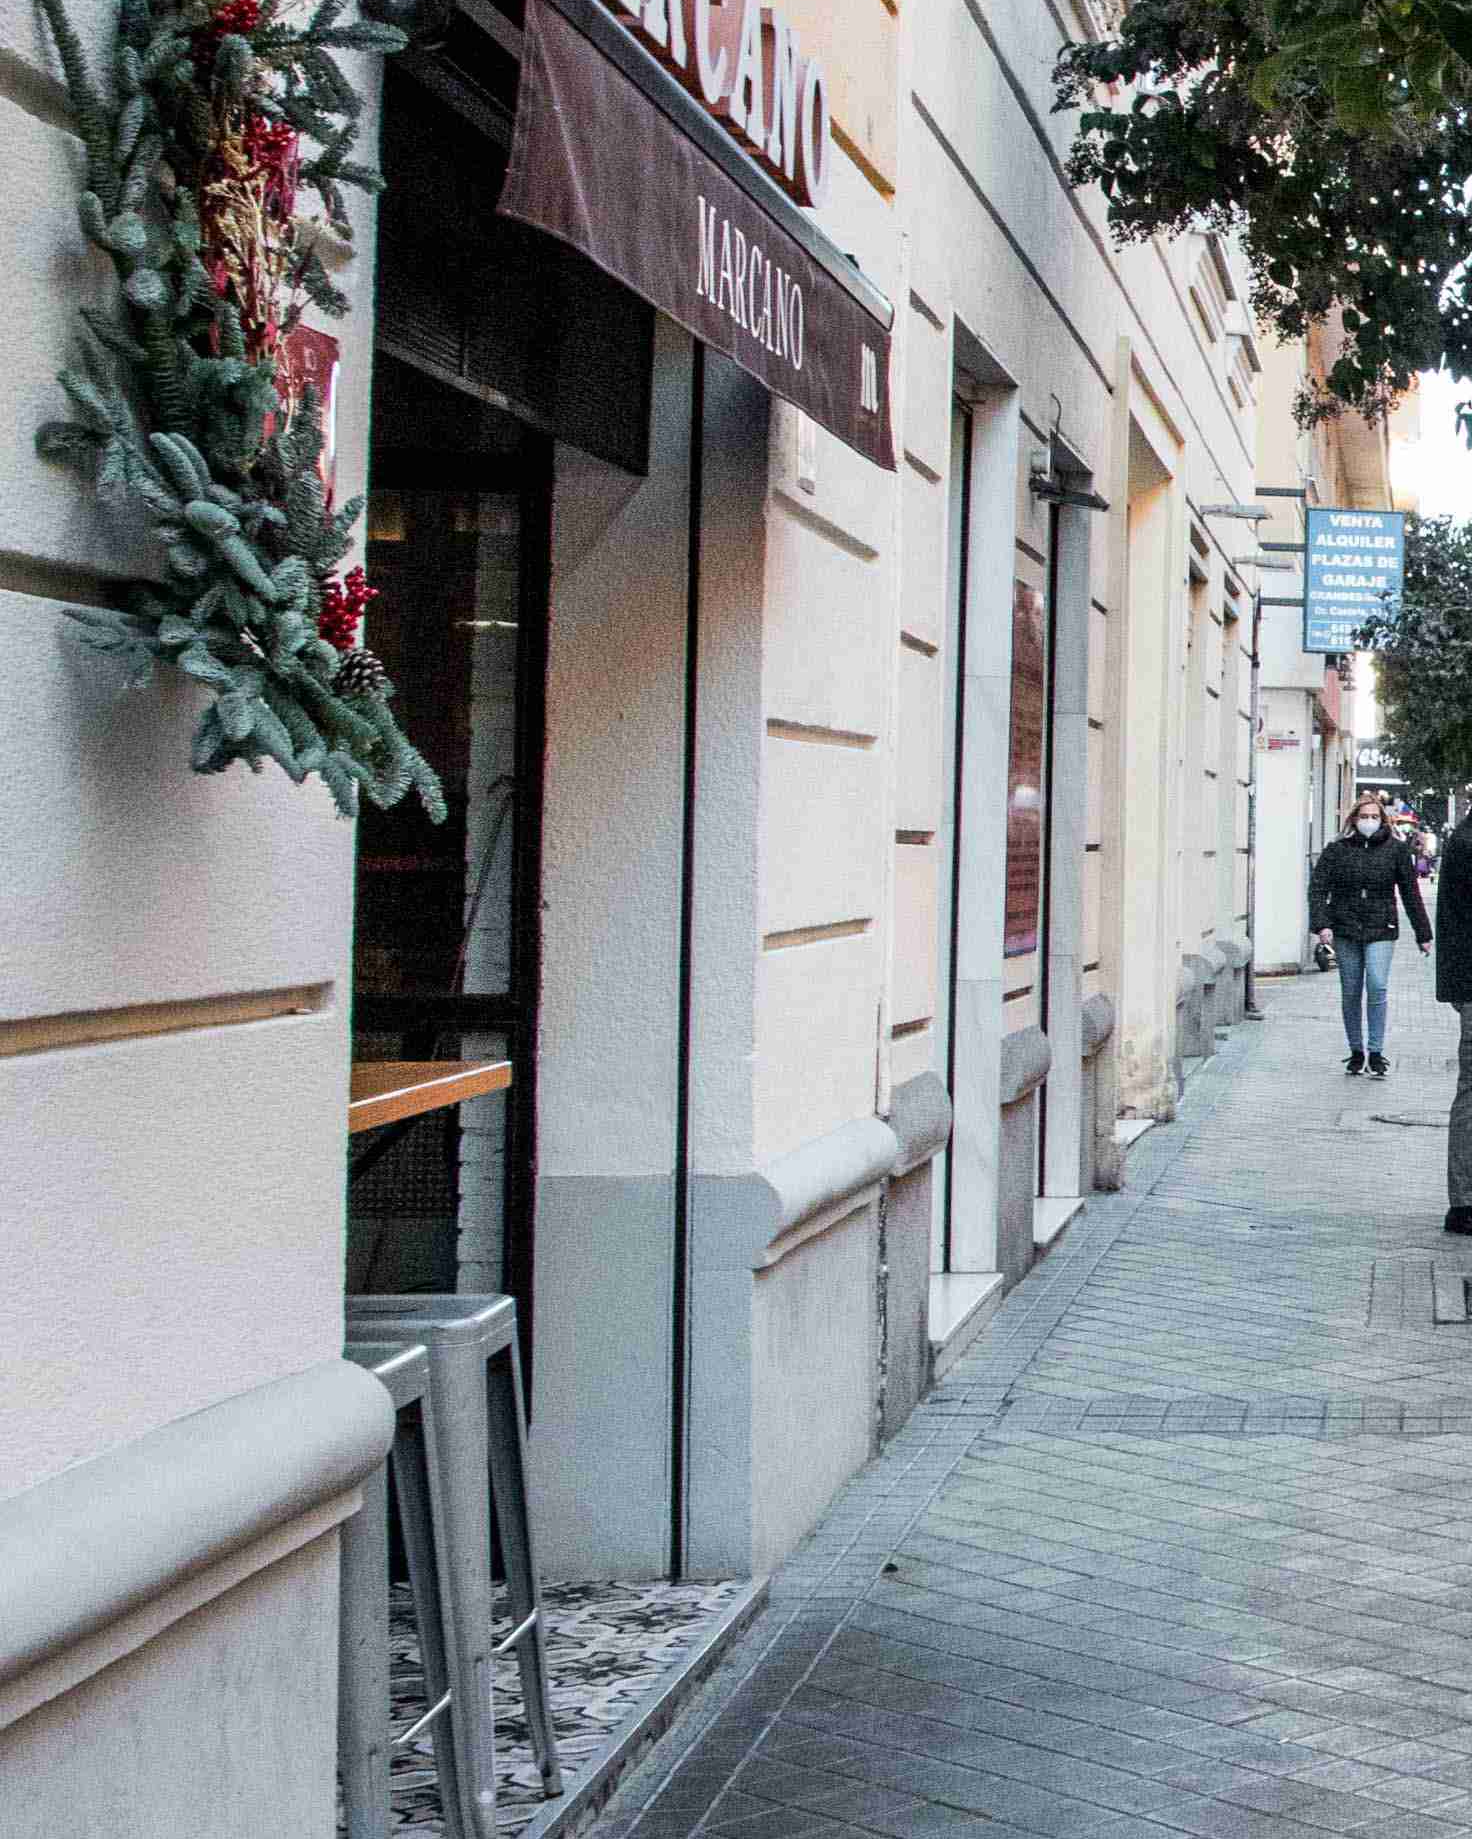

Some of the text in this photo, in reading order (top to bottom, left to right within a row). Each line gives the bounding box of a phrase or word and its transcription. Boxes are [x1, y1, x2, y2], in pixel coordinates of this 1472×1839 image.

[696, 195, 804, 371] MARCANO
[1328, 514, 1384, 529] VENTA
[1315, 534, 1396, 549] ALQUILER
[1311, 554, 1400, 569] PLAZAS DE
[1322, 574, 1387, 588] GARAJE
